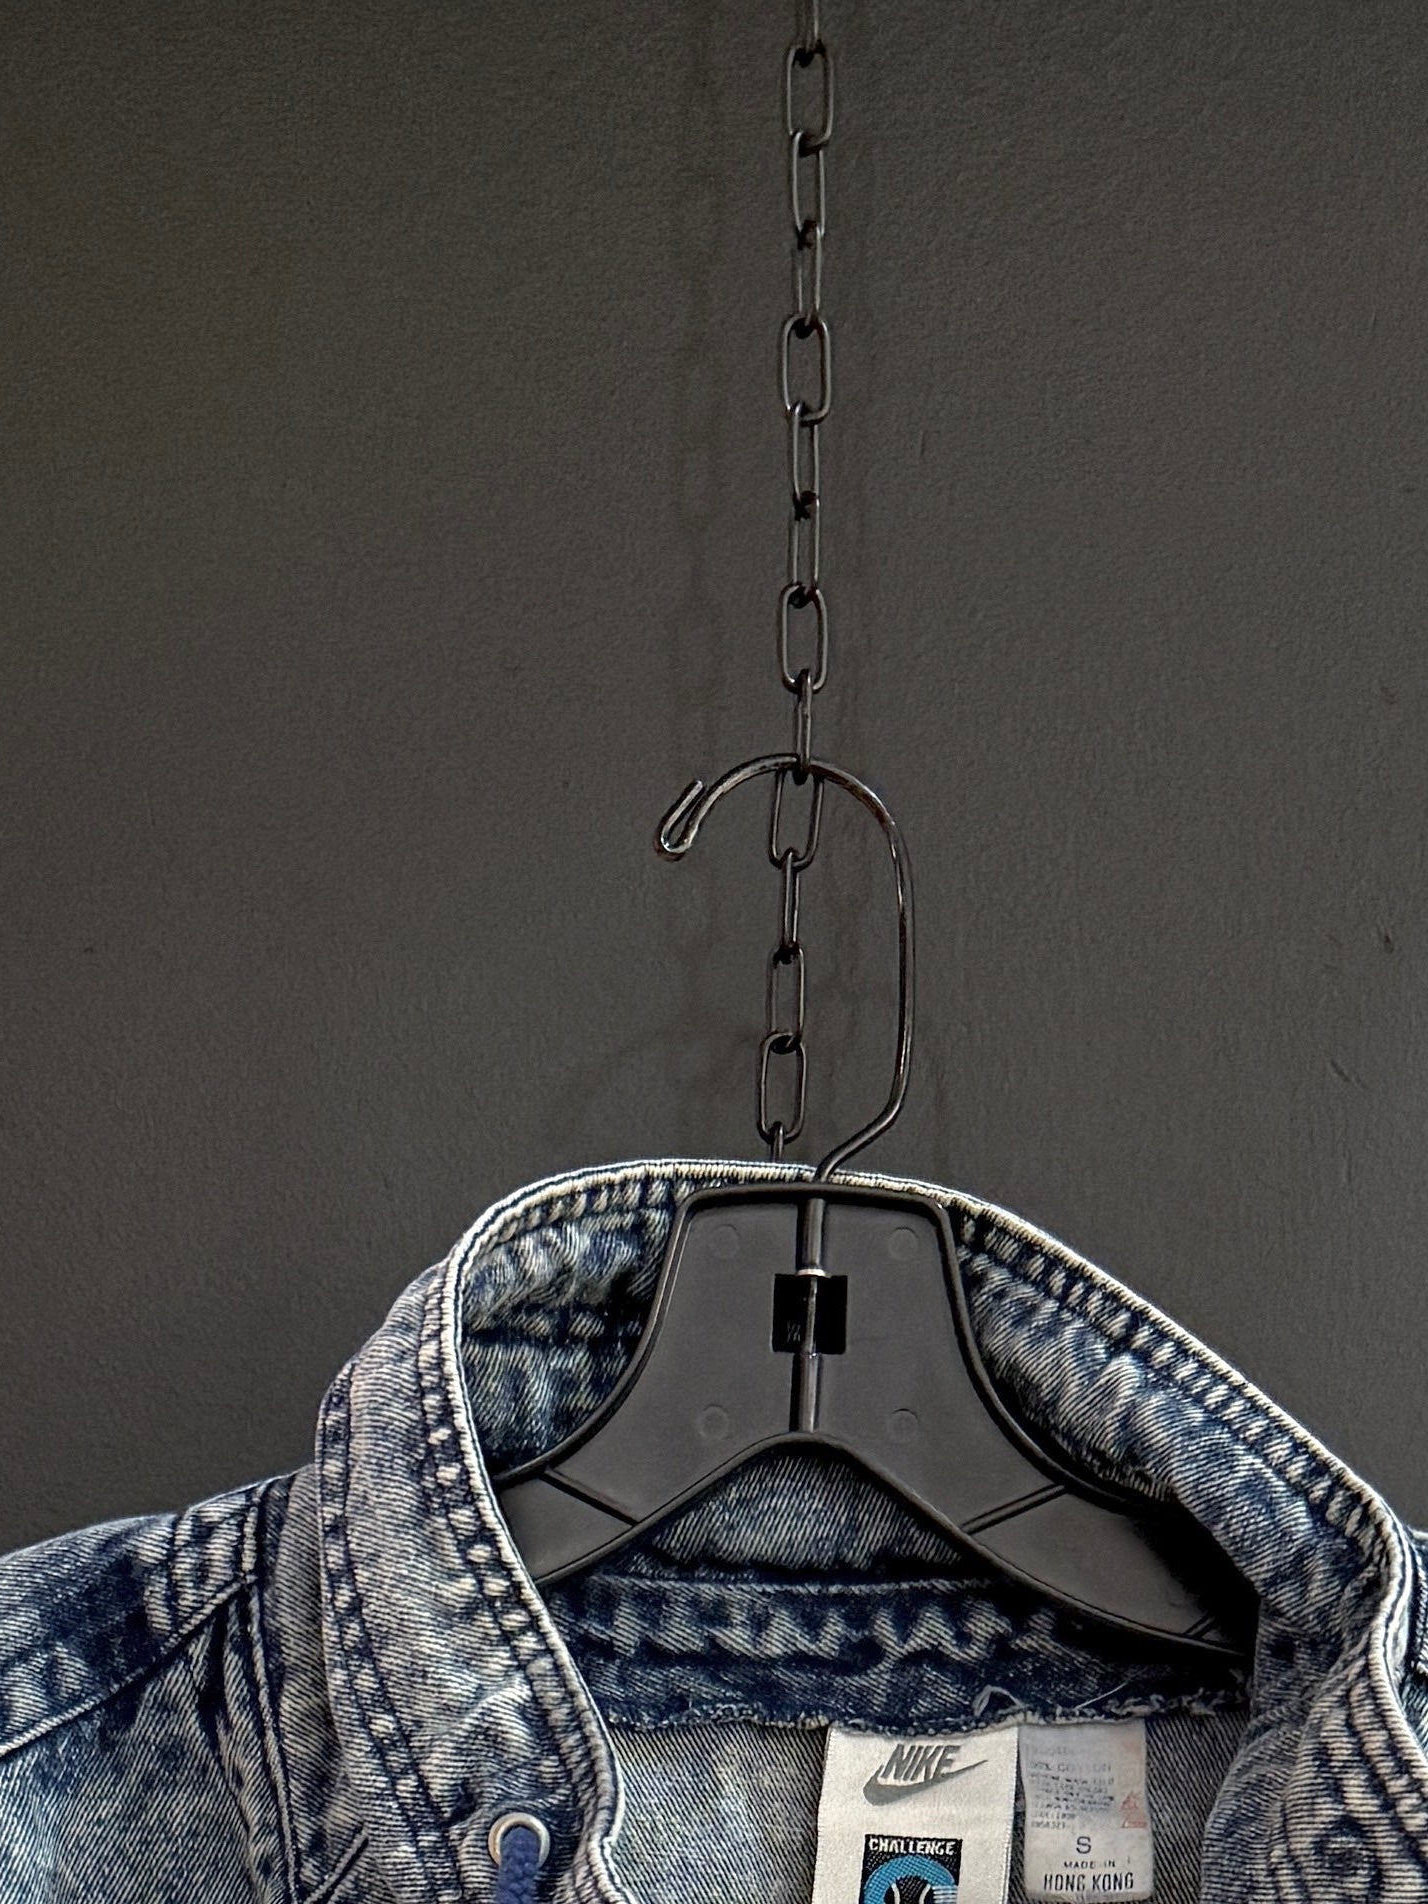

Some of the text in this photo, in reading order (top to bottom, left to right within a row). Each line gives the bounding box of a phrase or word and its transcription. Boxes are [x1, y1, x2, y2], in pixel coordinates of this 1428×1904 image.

[880, 1743, 961, 1782] NIKE
[868, 1837, 956, 1856] CHALLENGE
[1075, 1835, 1092, 1855] S
[1063, 1859, 1117, 1870] MADE IN
[1043, 1871, 1134, 1892] HONG KONG
